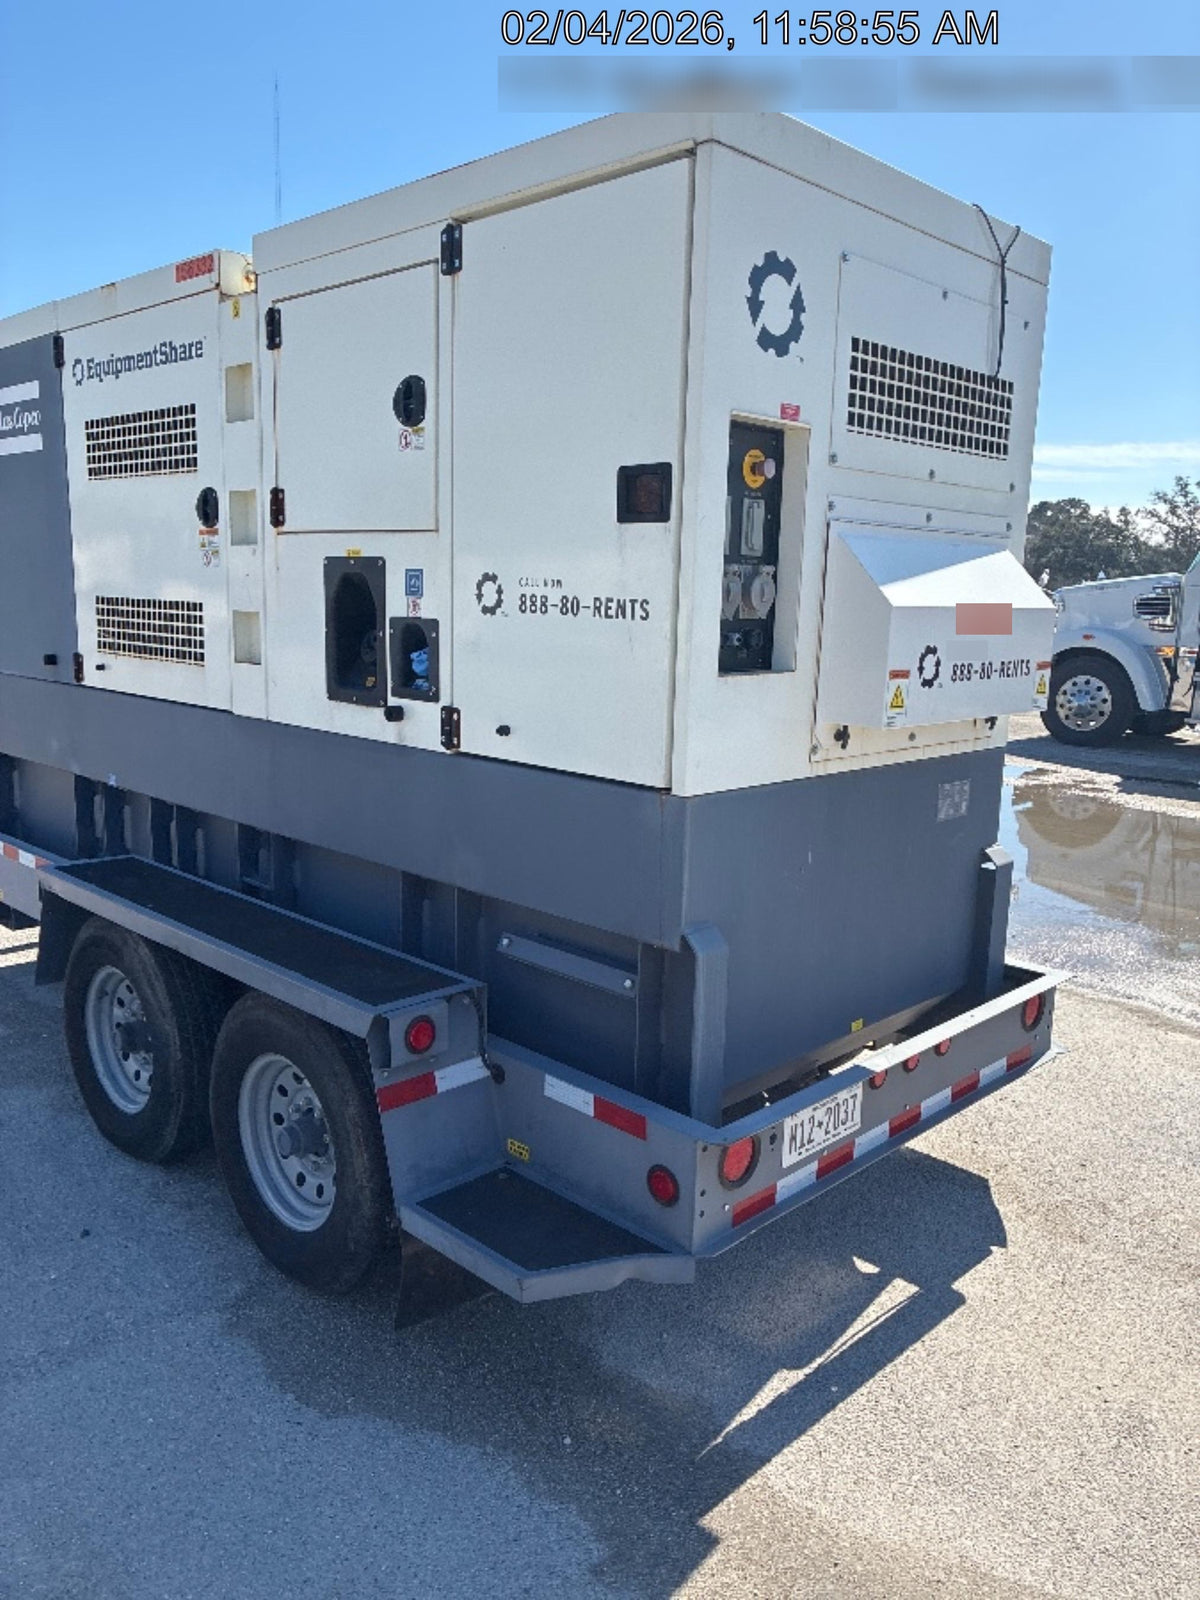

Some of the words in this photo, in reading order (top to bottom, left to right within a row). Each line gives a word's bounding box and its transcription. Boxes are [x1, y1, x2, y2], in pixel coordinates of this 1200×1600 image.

[86, 339, 204, 383] EquipmentShare
[518, 593, 650, 621] 888-80-RENTS
[951, 659, 1031, 683] 888-80-RENTS
